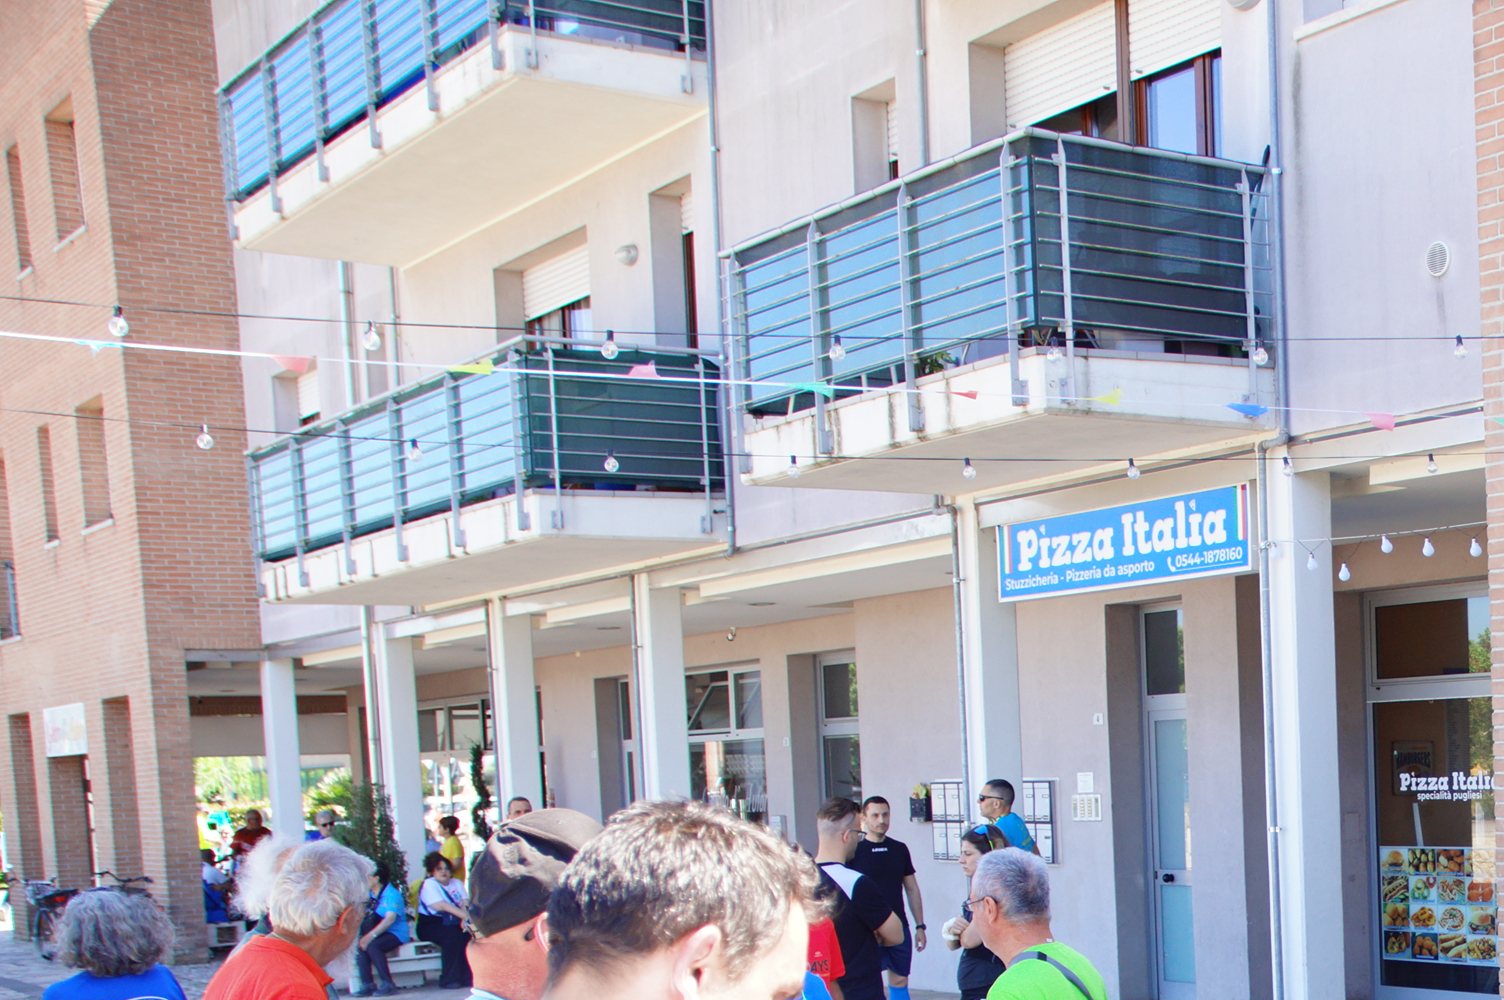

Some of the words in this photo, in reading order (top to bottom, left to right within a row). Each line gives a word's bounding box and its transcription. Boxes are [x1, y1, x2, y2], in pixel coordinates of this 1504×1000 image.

[1017, 524, 1114, 571] Pizza
[1121, 499, 1227, 556] Italia
[1175, 546, 1243, 568] 0544-1878160
[1005, 572, 1059, 591] Stuzzicheria
[1066, 566, 1102, 583] Pizzeria
[1103, 564, 1116, 578] da
[1117, 560, 1155, 577] asporto
[1400, 771, 1449, 791] Pizza
[1453, 791, 1483, 802] pugliesi
